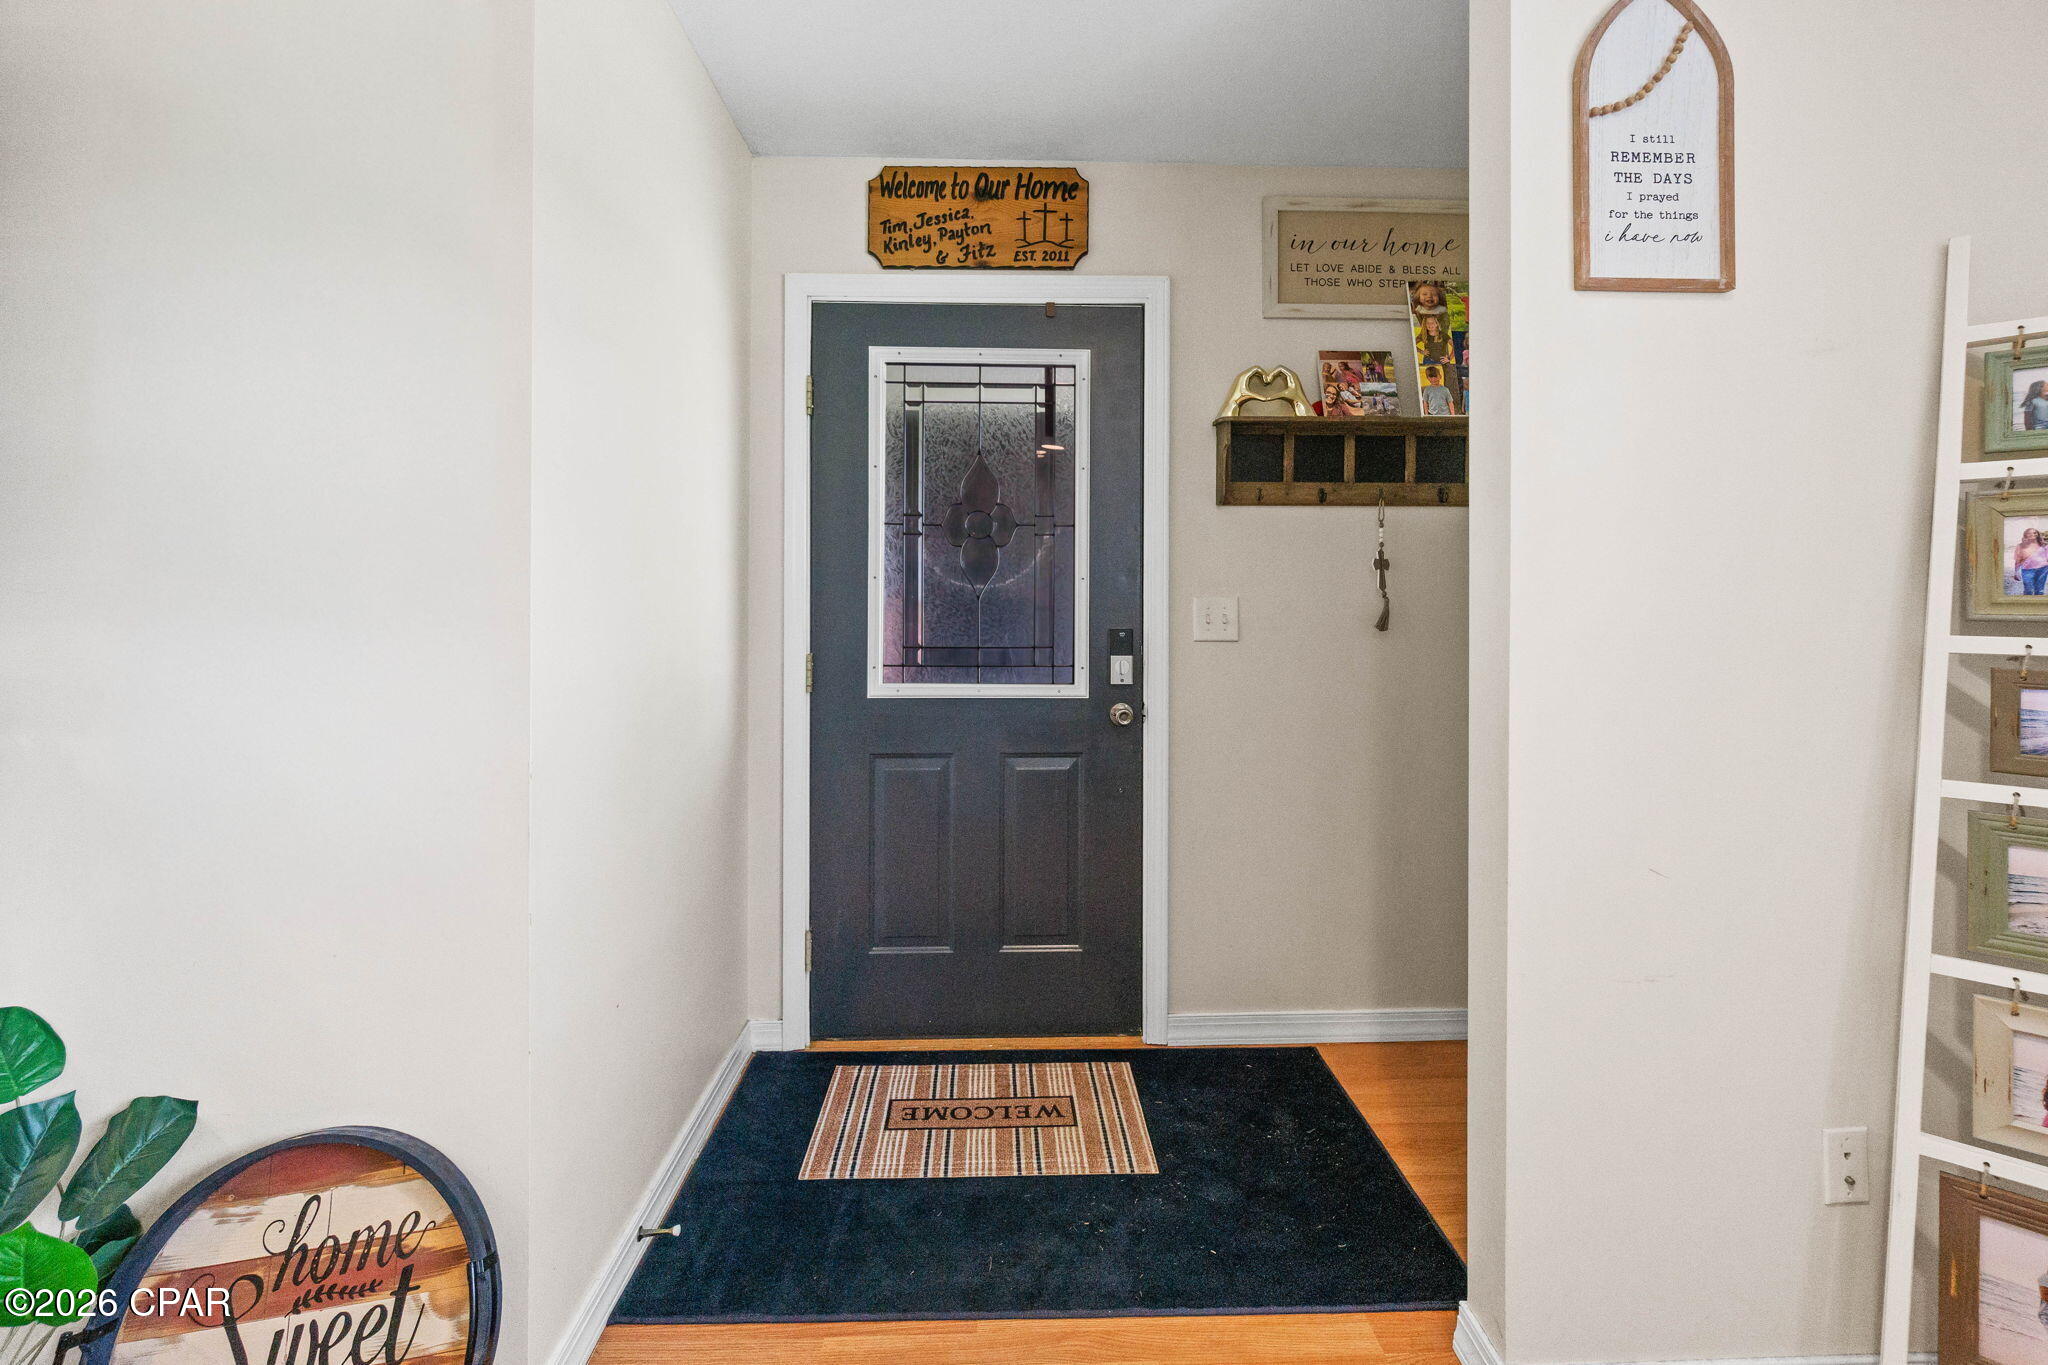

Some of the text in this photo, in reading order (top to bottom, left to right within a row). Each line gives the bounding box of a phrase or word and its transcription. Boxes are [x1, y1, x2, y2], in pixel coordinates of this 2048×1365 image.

[1642, 135, 1675, 143] still
[1611, 152, 1696, 163] REMEMBER
[1614, 172, 1693, 184] THE DAYS
[880, 171, 1080, 201] Welcome to Our Home
[1627, 192, 1679, 202] I prayed
[1609, 210, 1698, 221] for the things
[880, 219, 912, 234] Tim,
[1604, 223, 1703, 243] i have now
[884, 223, 991, 254] Kinley, Payton
[1291, 228, 1460, 257] in our home
[936, 244, 996, 264] & Fitz
[1014, 251, 1069, 262] EST. 2011
[1291, 264, 1460, 275] LET LOVE ABIDE & BLESS ALL
[1305, 278, 1405, 288] THOSE WHO STEP
[903, 1104, 1066, 1120] WELCOME
[262, 1194, 436, 1292] home
